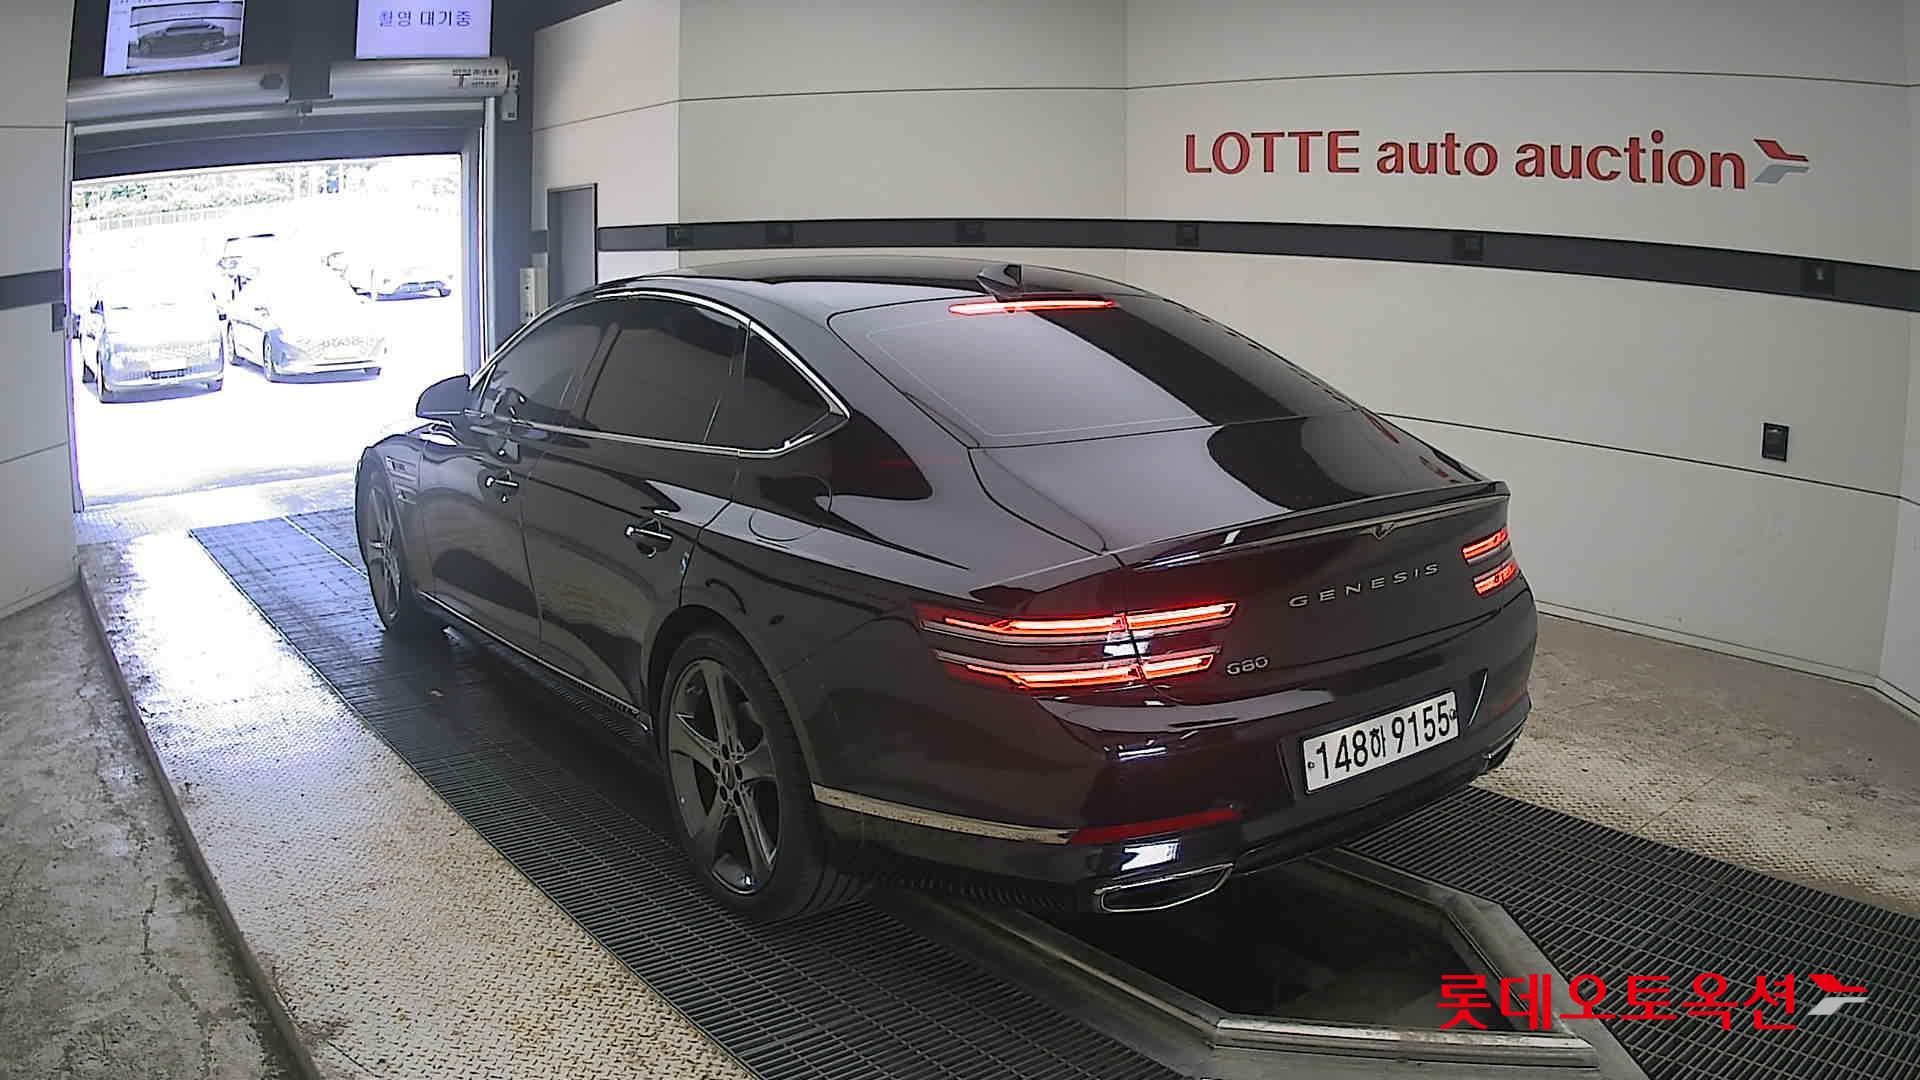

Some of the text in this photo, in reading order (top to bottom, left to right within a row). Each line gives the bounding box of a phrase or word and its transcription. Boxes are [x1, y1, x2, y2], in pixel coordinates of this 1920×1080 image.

[420, 10, 472, 27] 대기중
[1184, 130, 1745, 190] LOTTE auto auction
[1288, 563, 1439, 607] GENESIS
[1226, 655, 1269, 676] G80
[1316, 700, 1450, 780] 148하 9155
